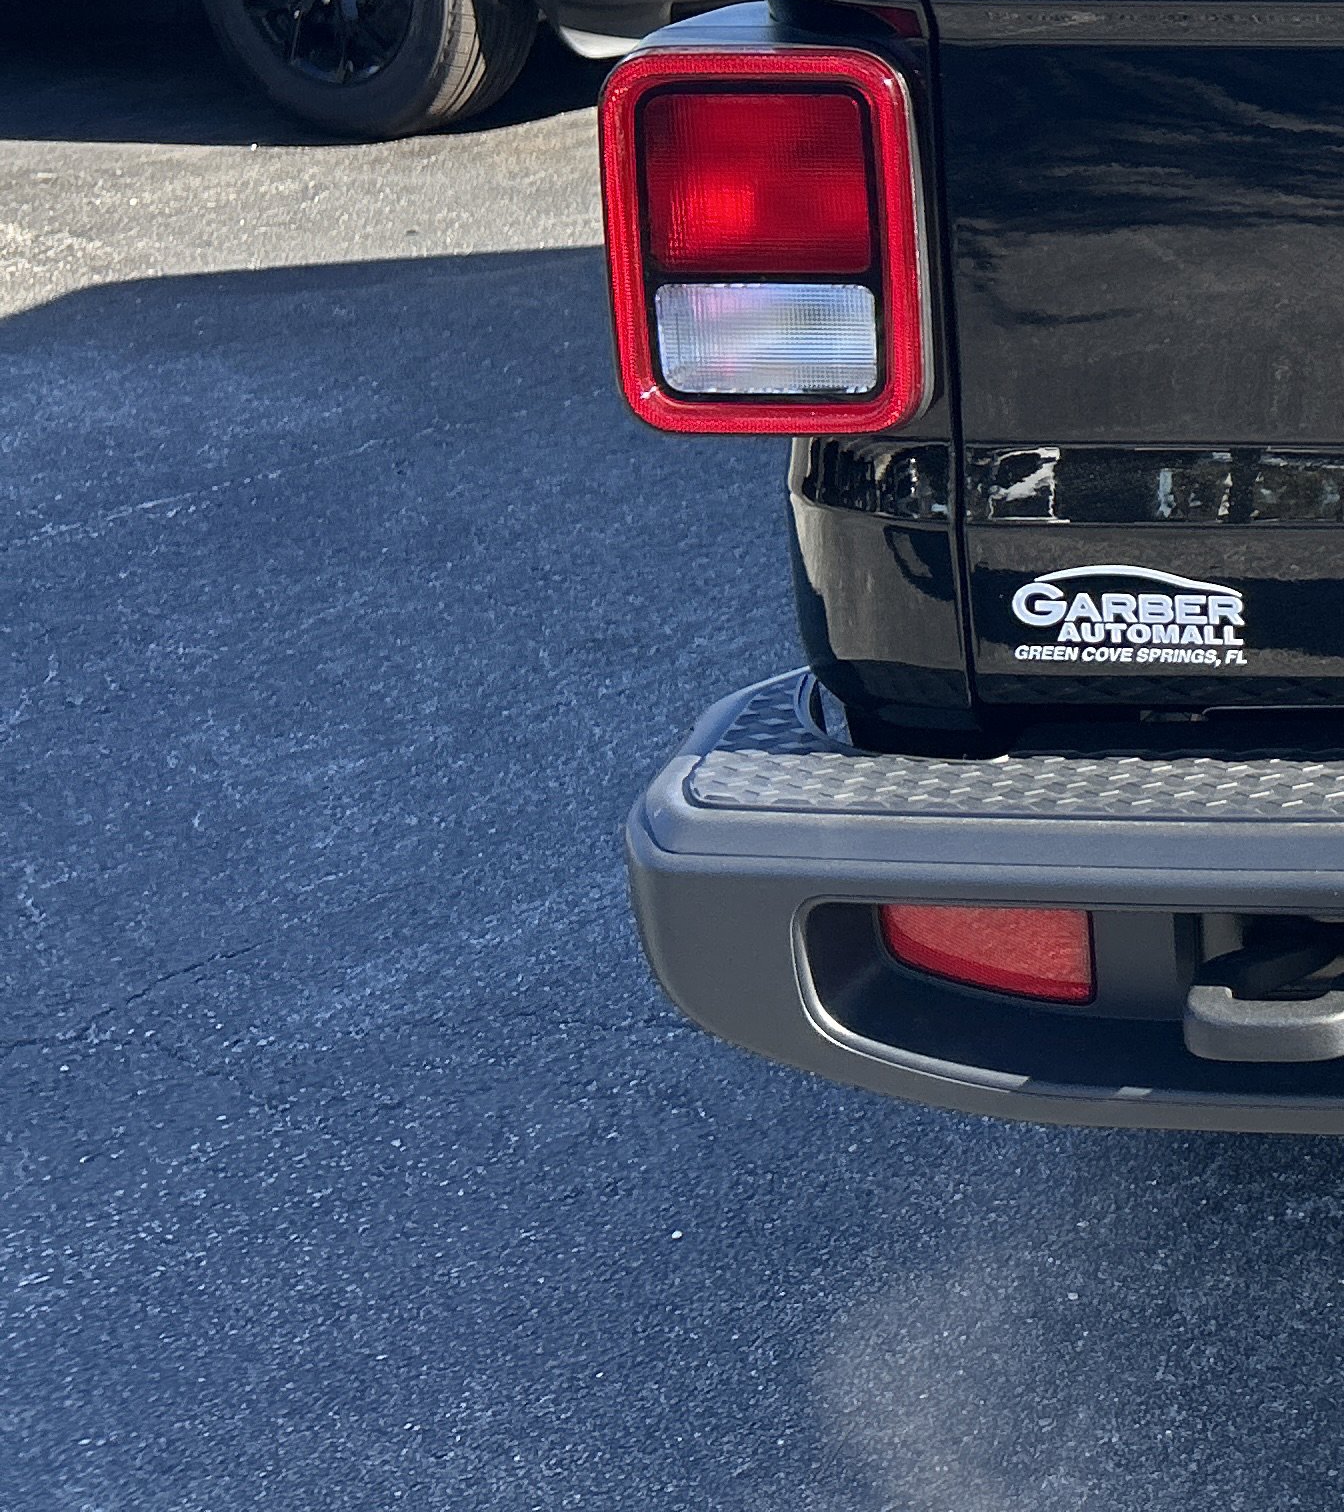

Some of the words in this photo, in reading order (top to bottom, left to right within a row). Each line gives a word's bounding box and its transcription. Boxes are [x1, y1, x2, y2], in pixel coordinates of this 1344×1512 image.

[1012, 582, 1245, 626] GARBER
[1057, 622, 1244, 646] AUTOMALL
[1014, 645, 1079, 662] GREEN
[1081, 647, 1133, 663] COVE
[1136, 648, 1222, 667] SPRINGS,
[1225, 650, 1248, 665] FL
